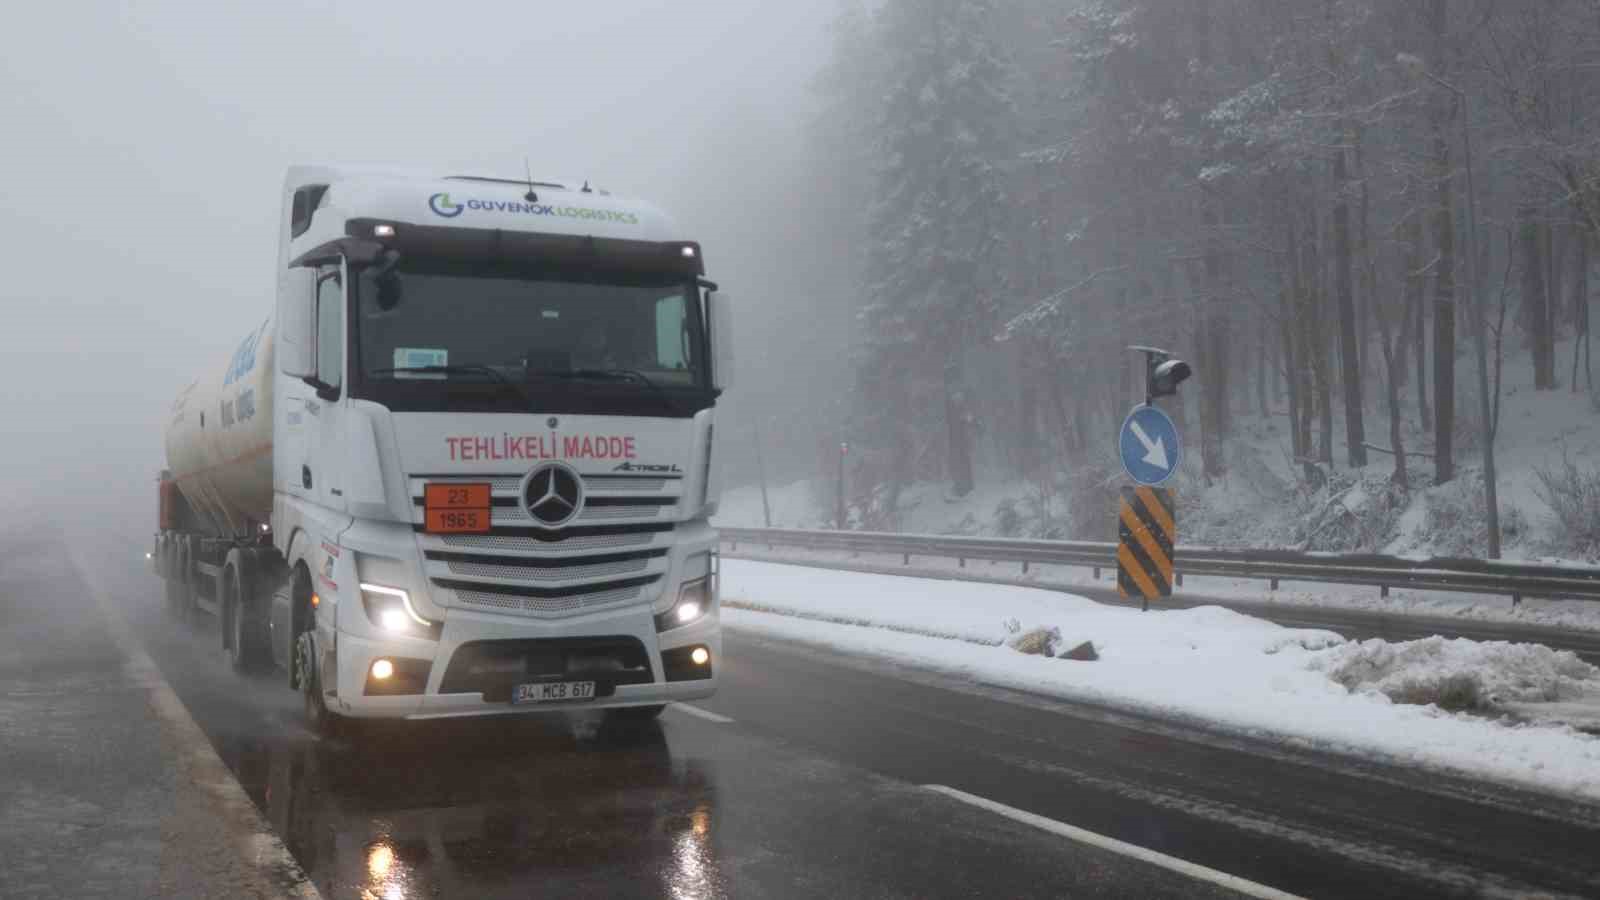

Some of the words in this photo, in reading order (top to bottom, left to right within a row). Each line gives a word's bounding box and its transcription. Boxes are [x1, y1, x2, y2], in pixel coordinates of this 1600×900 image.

[446, 431, 556, 461] TEHLİKELİ
[563, 436, 636, 459] MADDE
[447, 487, 470, 505] 23
[440, 511, 478, 529] 1965
[519, 685, 535, 699] 34
[572, 681, 593, 697] 617
